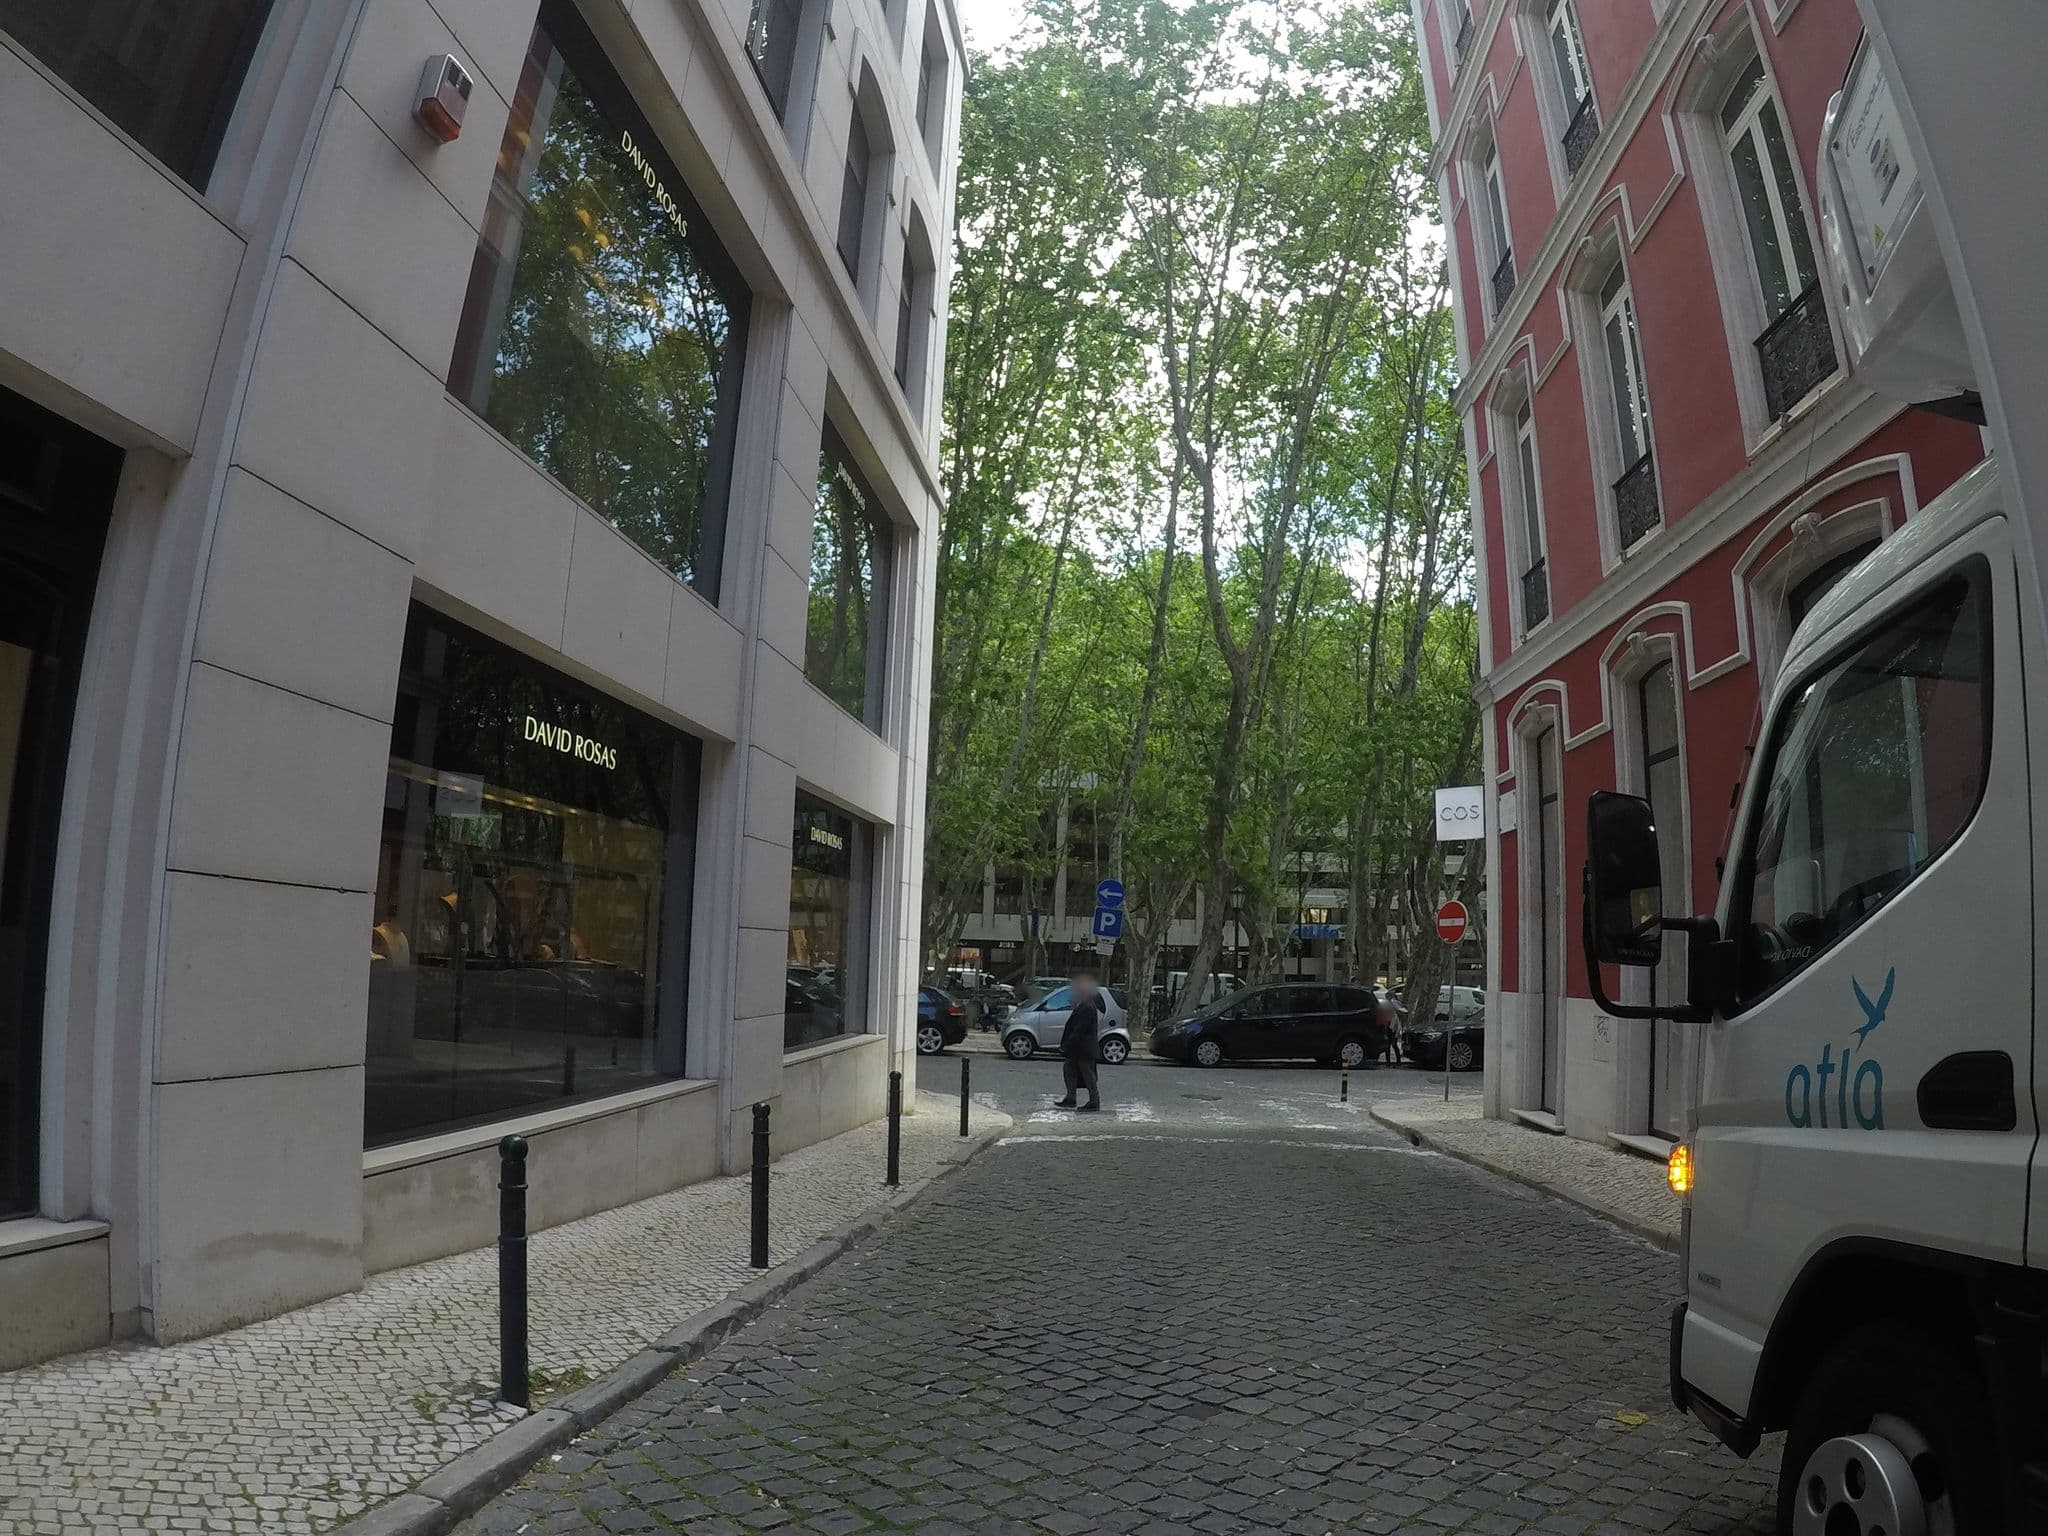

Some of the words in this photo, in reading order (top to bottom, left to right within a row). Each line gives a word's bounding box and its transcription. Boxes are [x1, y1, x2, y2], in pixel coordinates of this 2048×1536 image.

[621, 130, 656, 188] DAVID
[656, 182, 688, 238] ROSAS
[524, 715, 572, 753] DAVID
[575, 734, 617, 770] ROSAS
[1439, 805, 1480, 821] COS
[1100, 912, 1117, 932] P
[1785, 1043, 1885, 1131] atla
